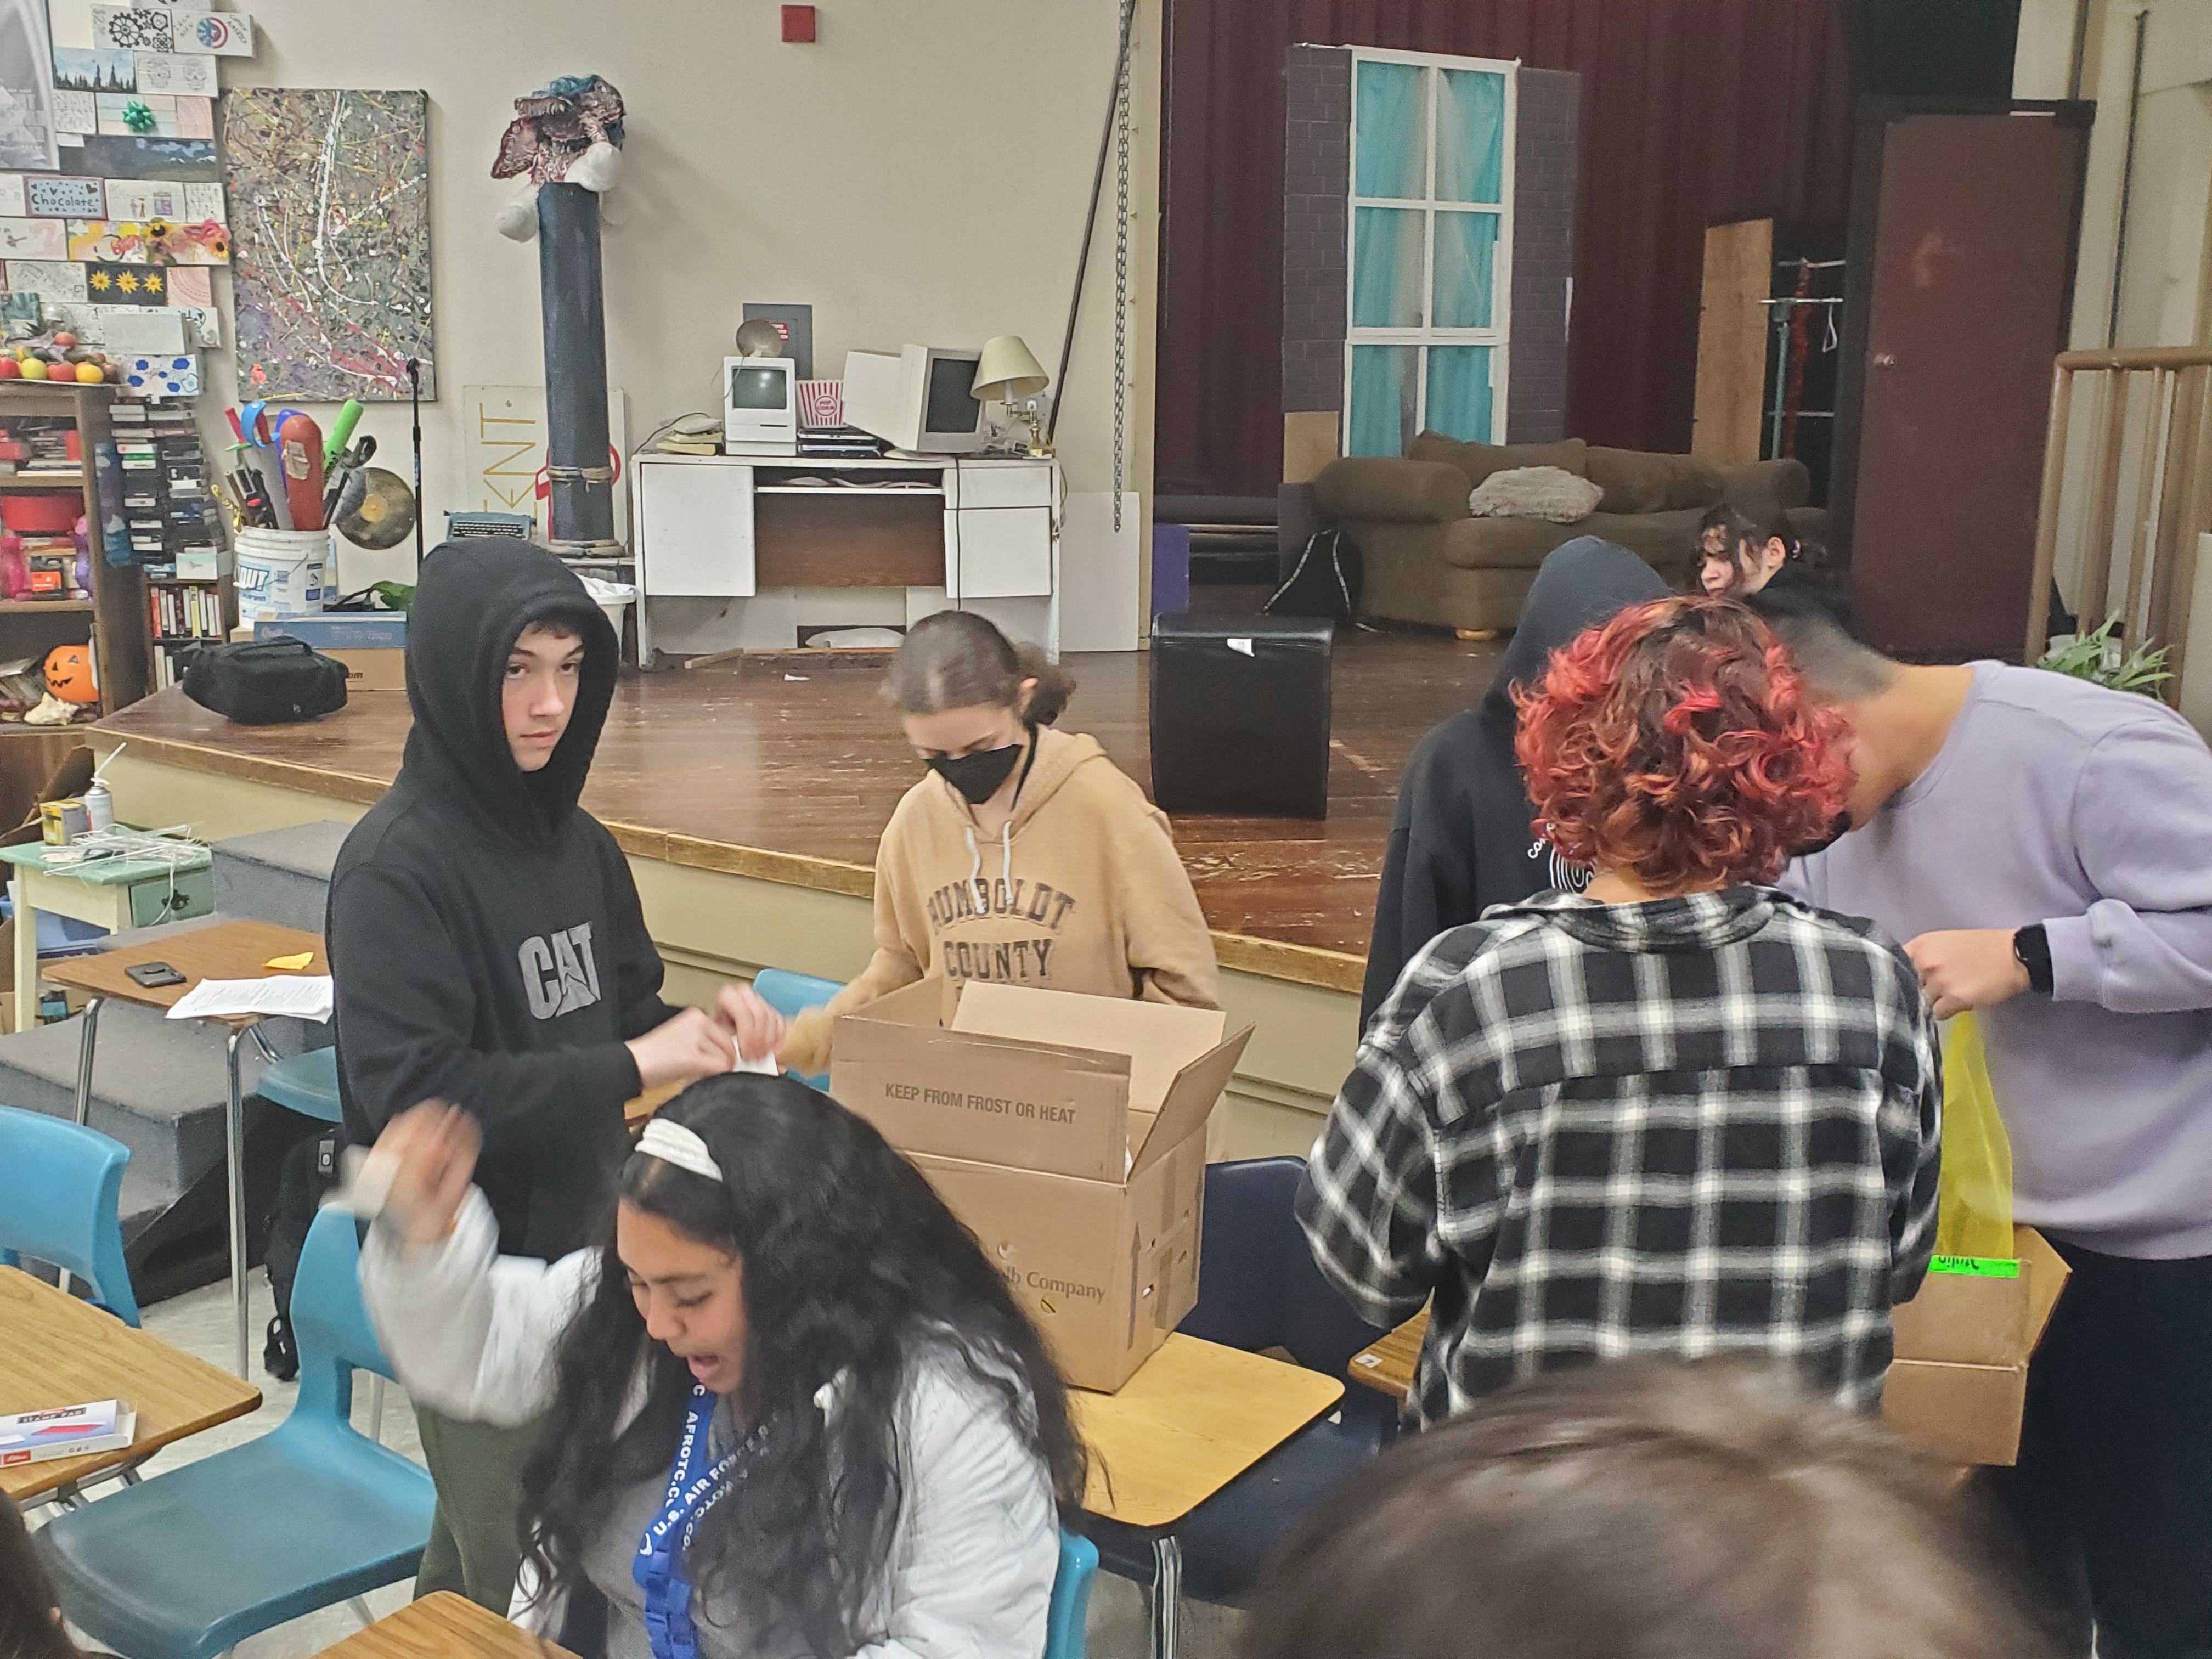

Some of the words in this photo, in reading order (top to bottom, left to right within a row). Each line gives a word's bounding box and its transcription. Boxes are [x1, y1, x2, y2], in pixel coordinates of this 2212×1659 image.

[31, 193, 94, 206] Chocolate
[238, 565, 268, 591] OUT
[518, 922, 601, 1019] CAT
[943, 939, 1052, 979] COUNTY
[885, 1083, 919, 1101] KEEP
[924, 1088, 963, 1108] FROM
[967, 1094, 1012, 1114] FROST
[1015, 1102, 1035, 1118] OR
[1040, 1105, 1076, 1124] HEAT
[1026, 1272, 1105, 1304] Company
[653, 1509, 685, 1536] U.S.
[684, 1479, 711, 1505] AIR
